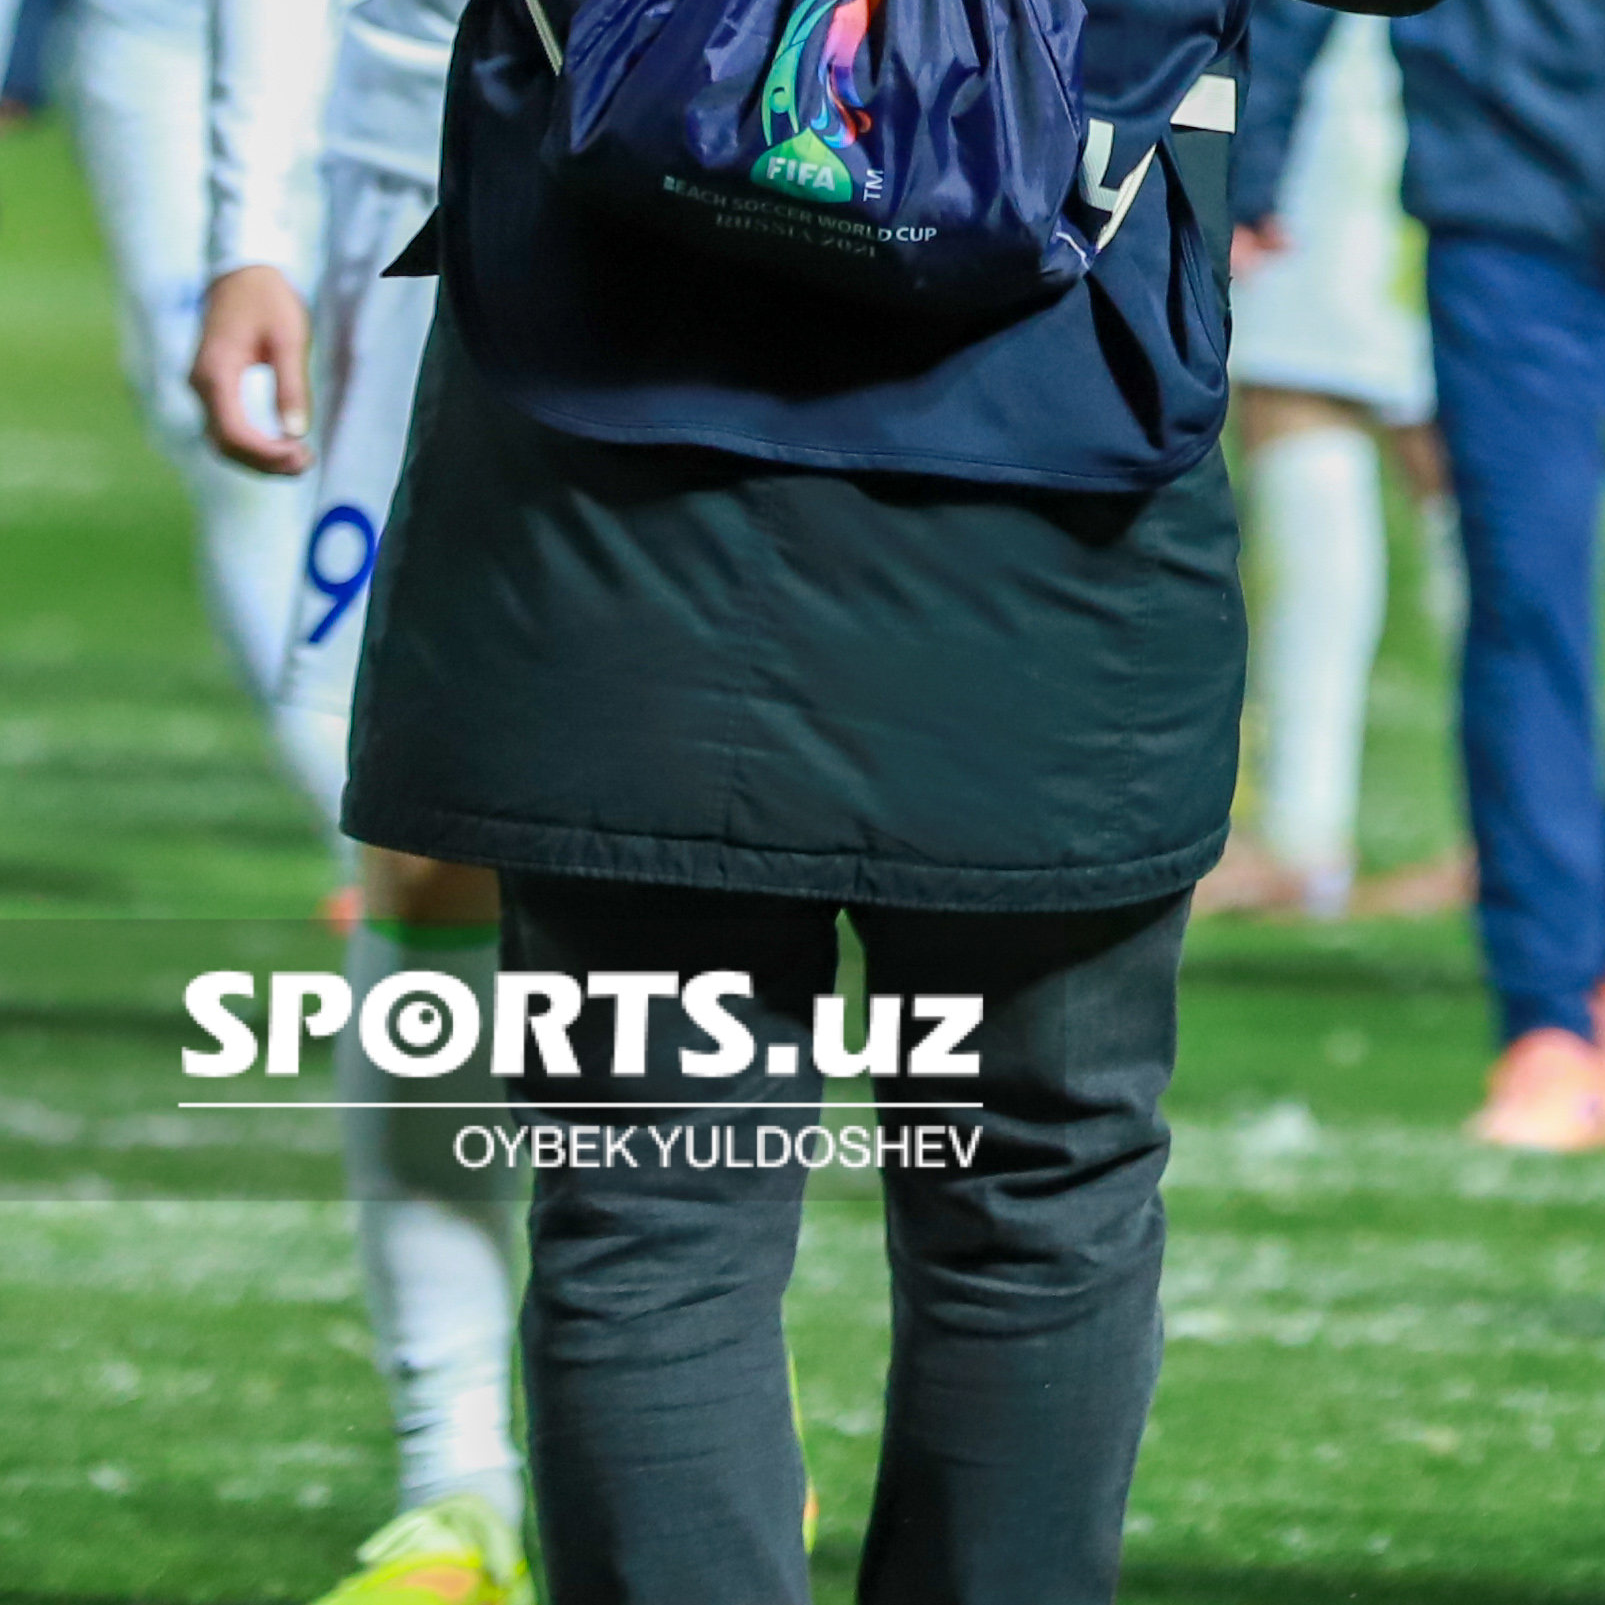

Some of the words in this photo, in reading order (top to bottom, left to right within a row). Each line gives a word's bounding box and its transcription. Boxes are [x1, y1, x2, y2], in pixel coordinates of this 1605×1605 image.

[765, 155, 836, 192] FIFA
[863, 168, 884, 202] TM
[662, 175, 727, 208] BEACH
[731, 196, 813, 225] SOCCER
[817, 213, 893, 242] WORLD
[895, 226, 938, 242] CUP
[306, 505, 377, 644] 9
